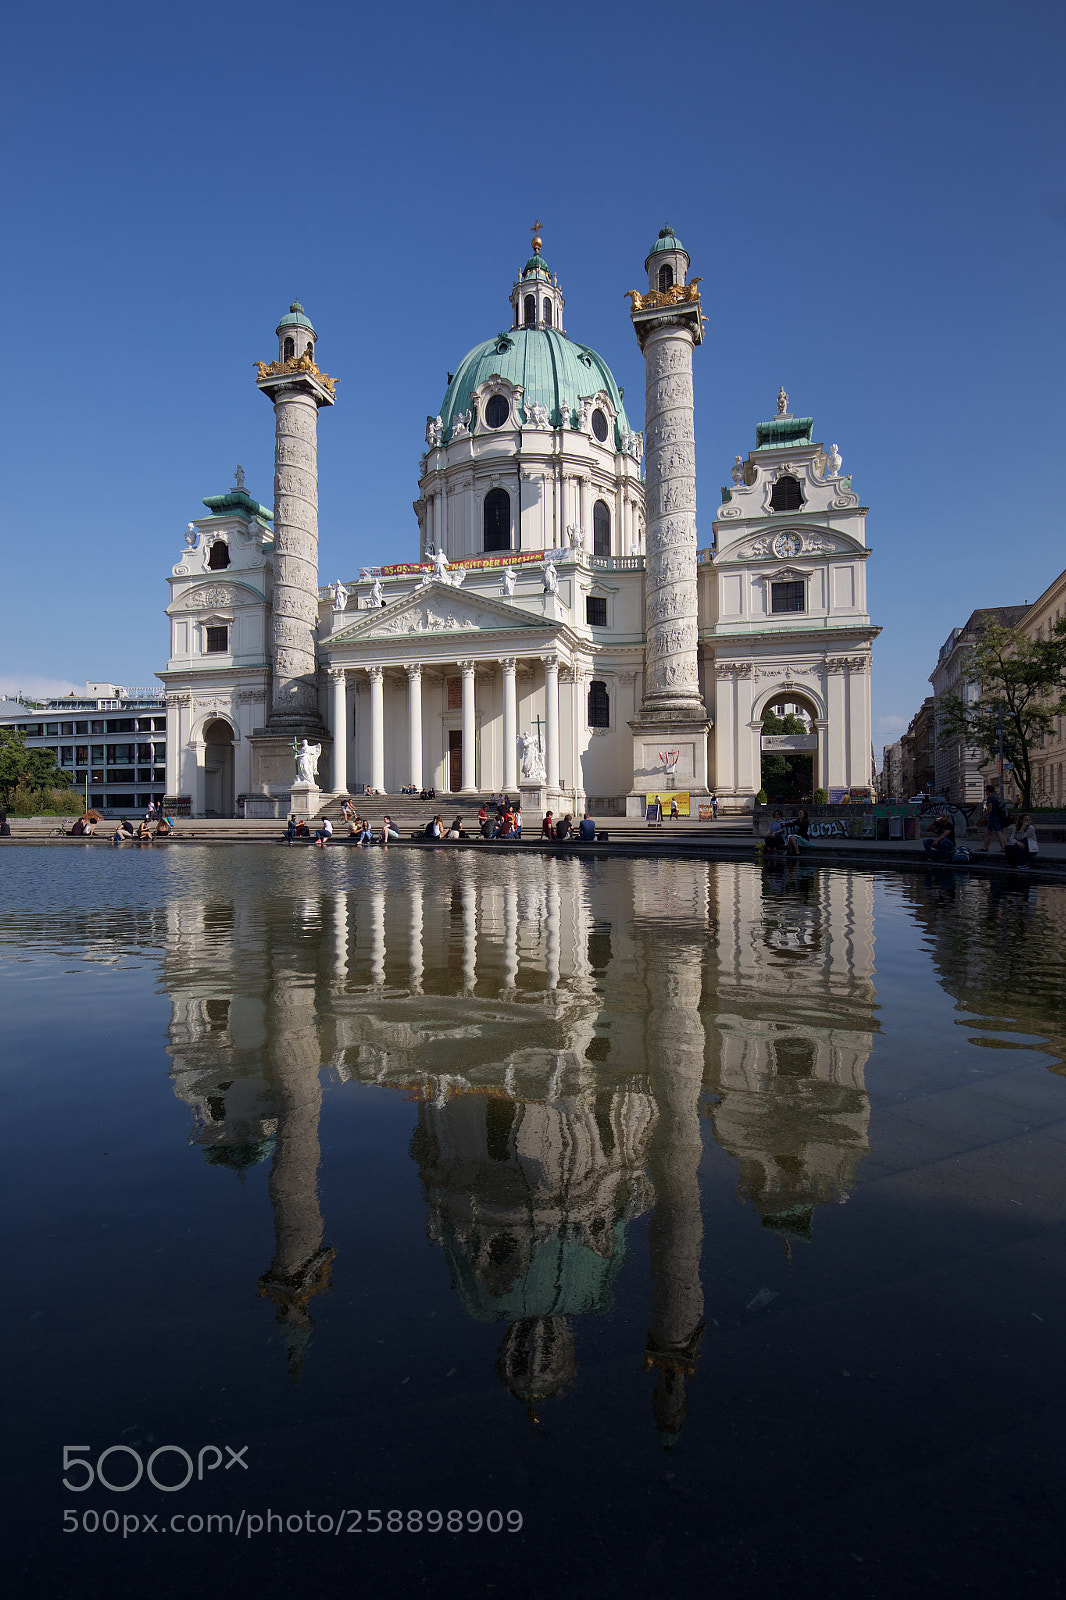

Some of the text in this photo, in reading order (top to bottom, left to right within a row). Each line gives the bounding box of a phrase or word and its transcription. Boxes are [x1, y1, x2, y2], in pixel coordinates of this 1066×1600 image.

[451, 561, 482, 571] NACHT
[482, 559, 500, 568] DER
[502, 554, 542, 566] KIRCHEN
